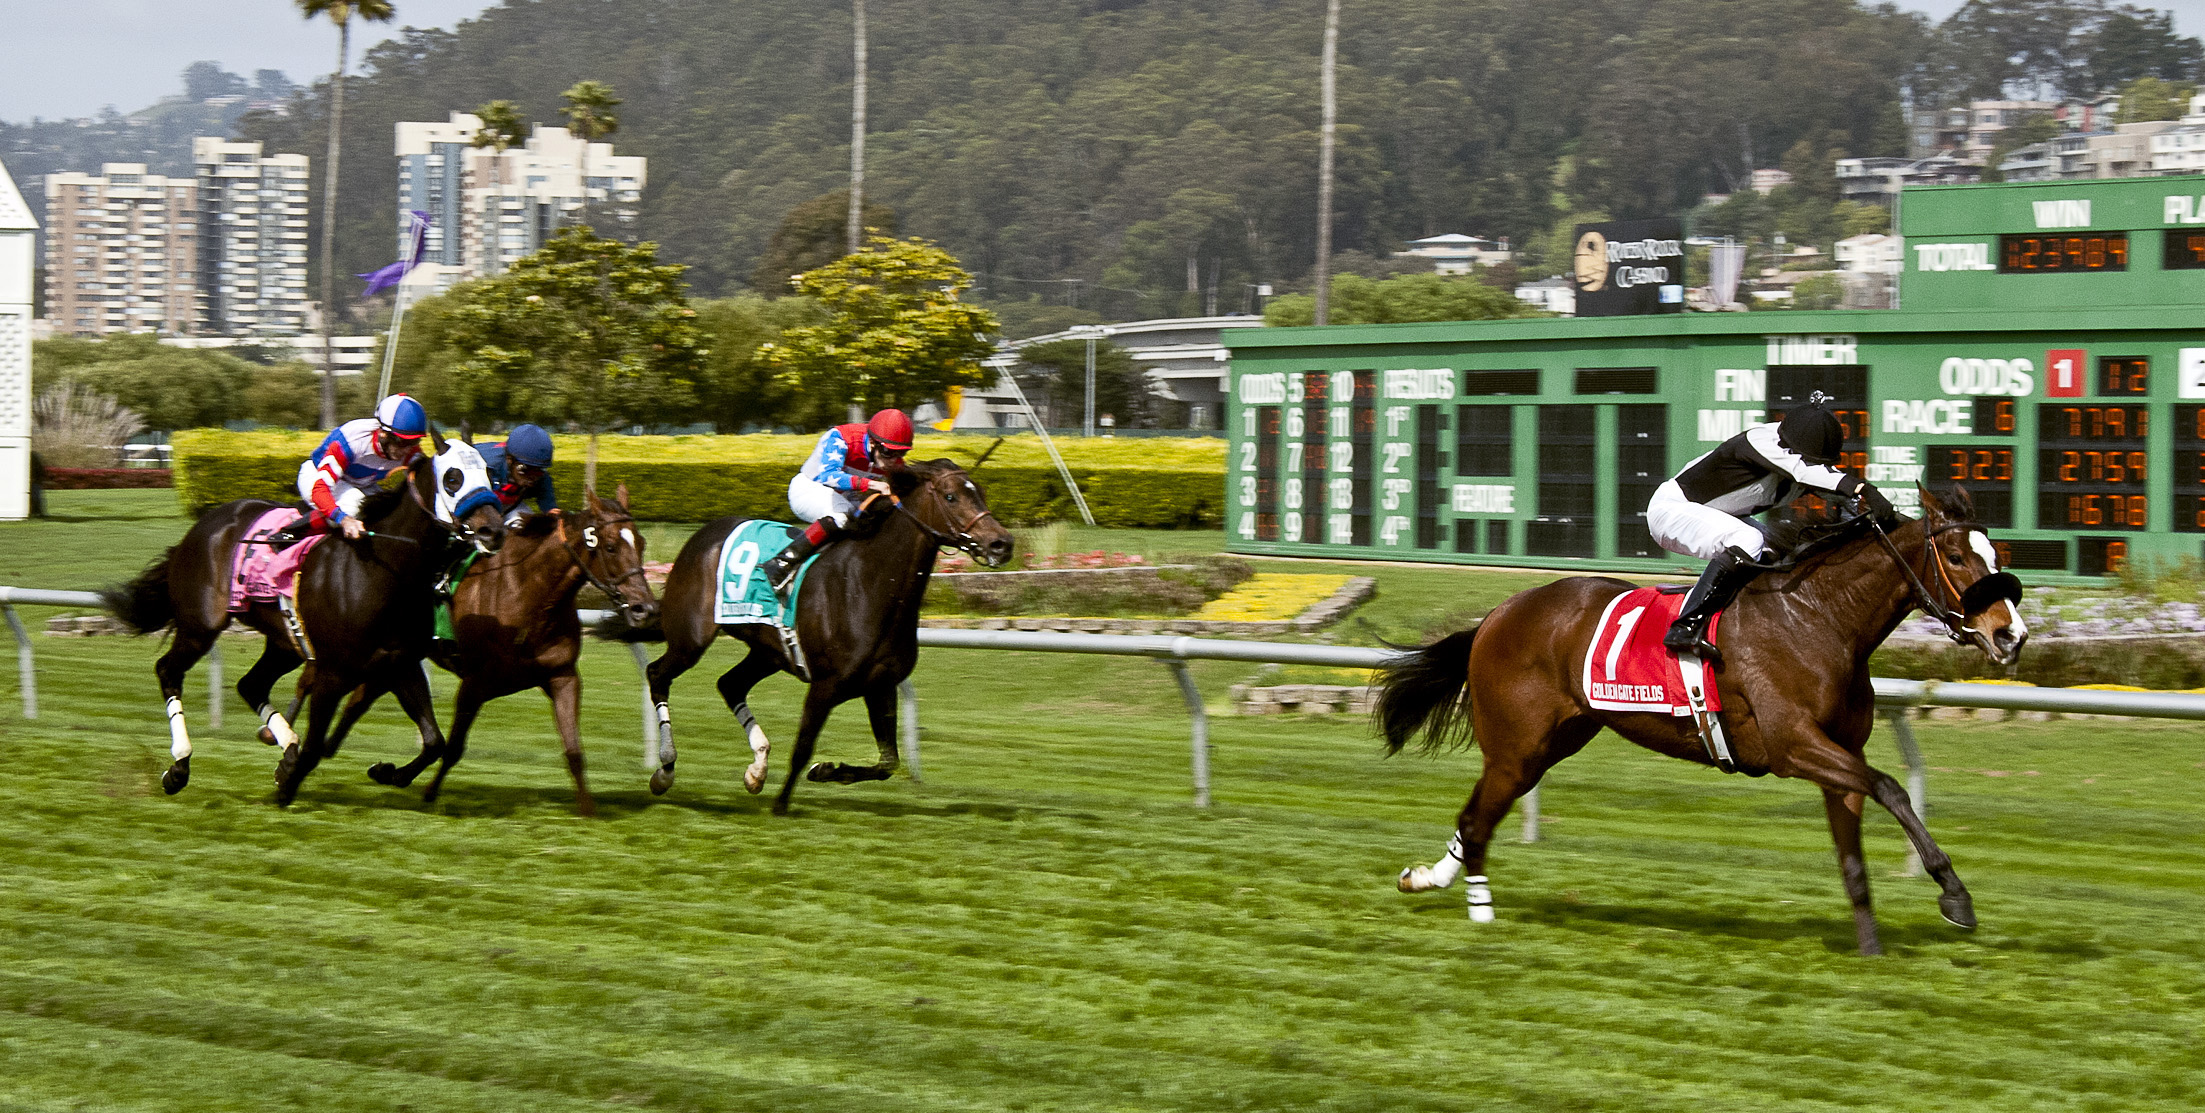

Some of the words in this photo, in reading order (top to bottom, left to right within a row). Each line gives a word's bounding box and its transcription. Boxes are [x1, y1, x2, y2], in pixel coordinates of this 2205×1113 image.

[2032, 200, 2091, 228] WIN
[1913, 243, 1996, 272] TOTAL
[1763, 334, 1858, 365] TIMER
[1287, 372, 1305, 403] 5
[1330, 371, 1355, 402] 10
[1939, 357, 2034, 397] ODDS
[2053, 358, 2073, 388] 1
[2108, 361, 2149, 391] 12
[1242, 407, 1257, 436] 1
[1286, 407, 1304, 437] 6
[1330, 407, 1350, 436] 11
[1882, 399, 1973, 434] RACE
[1994, 401, 2016, 431] 6
[2063, 408, 2149, 436] 7791
[1241, 441, 1257, 471] 2
[1286, 442, 1304, 472] 7
[1329, 442, 1353, 472] 12
[1951, 450, 2012, 480] 323
[2059, 451, 2147, 481] 2759
[1239, 476, 1257, 506] 3
[1284, 478, 1303, 509] 8
[1329, 478, 1353, 509] 13
[2069, 494, 2147, 526] 1678
[583, 526, 599, 548] 5
[1238, 511, 1256, 540] 4
[1284, 512, 1302, 542] 9
[1328, 513, 1353, 544] 14
[725, 541, 760, 600] 9
[1606, 606, 1646, 681] 1
[1592, 682, 1618, 700] GOLDEN
[1618, 684, 1634, 701] GATE
[1634, 685, 1664, 702] FIELDS
